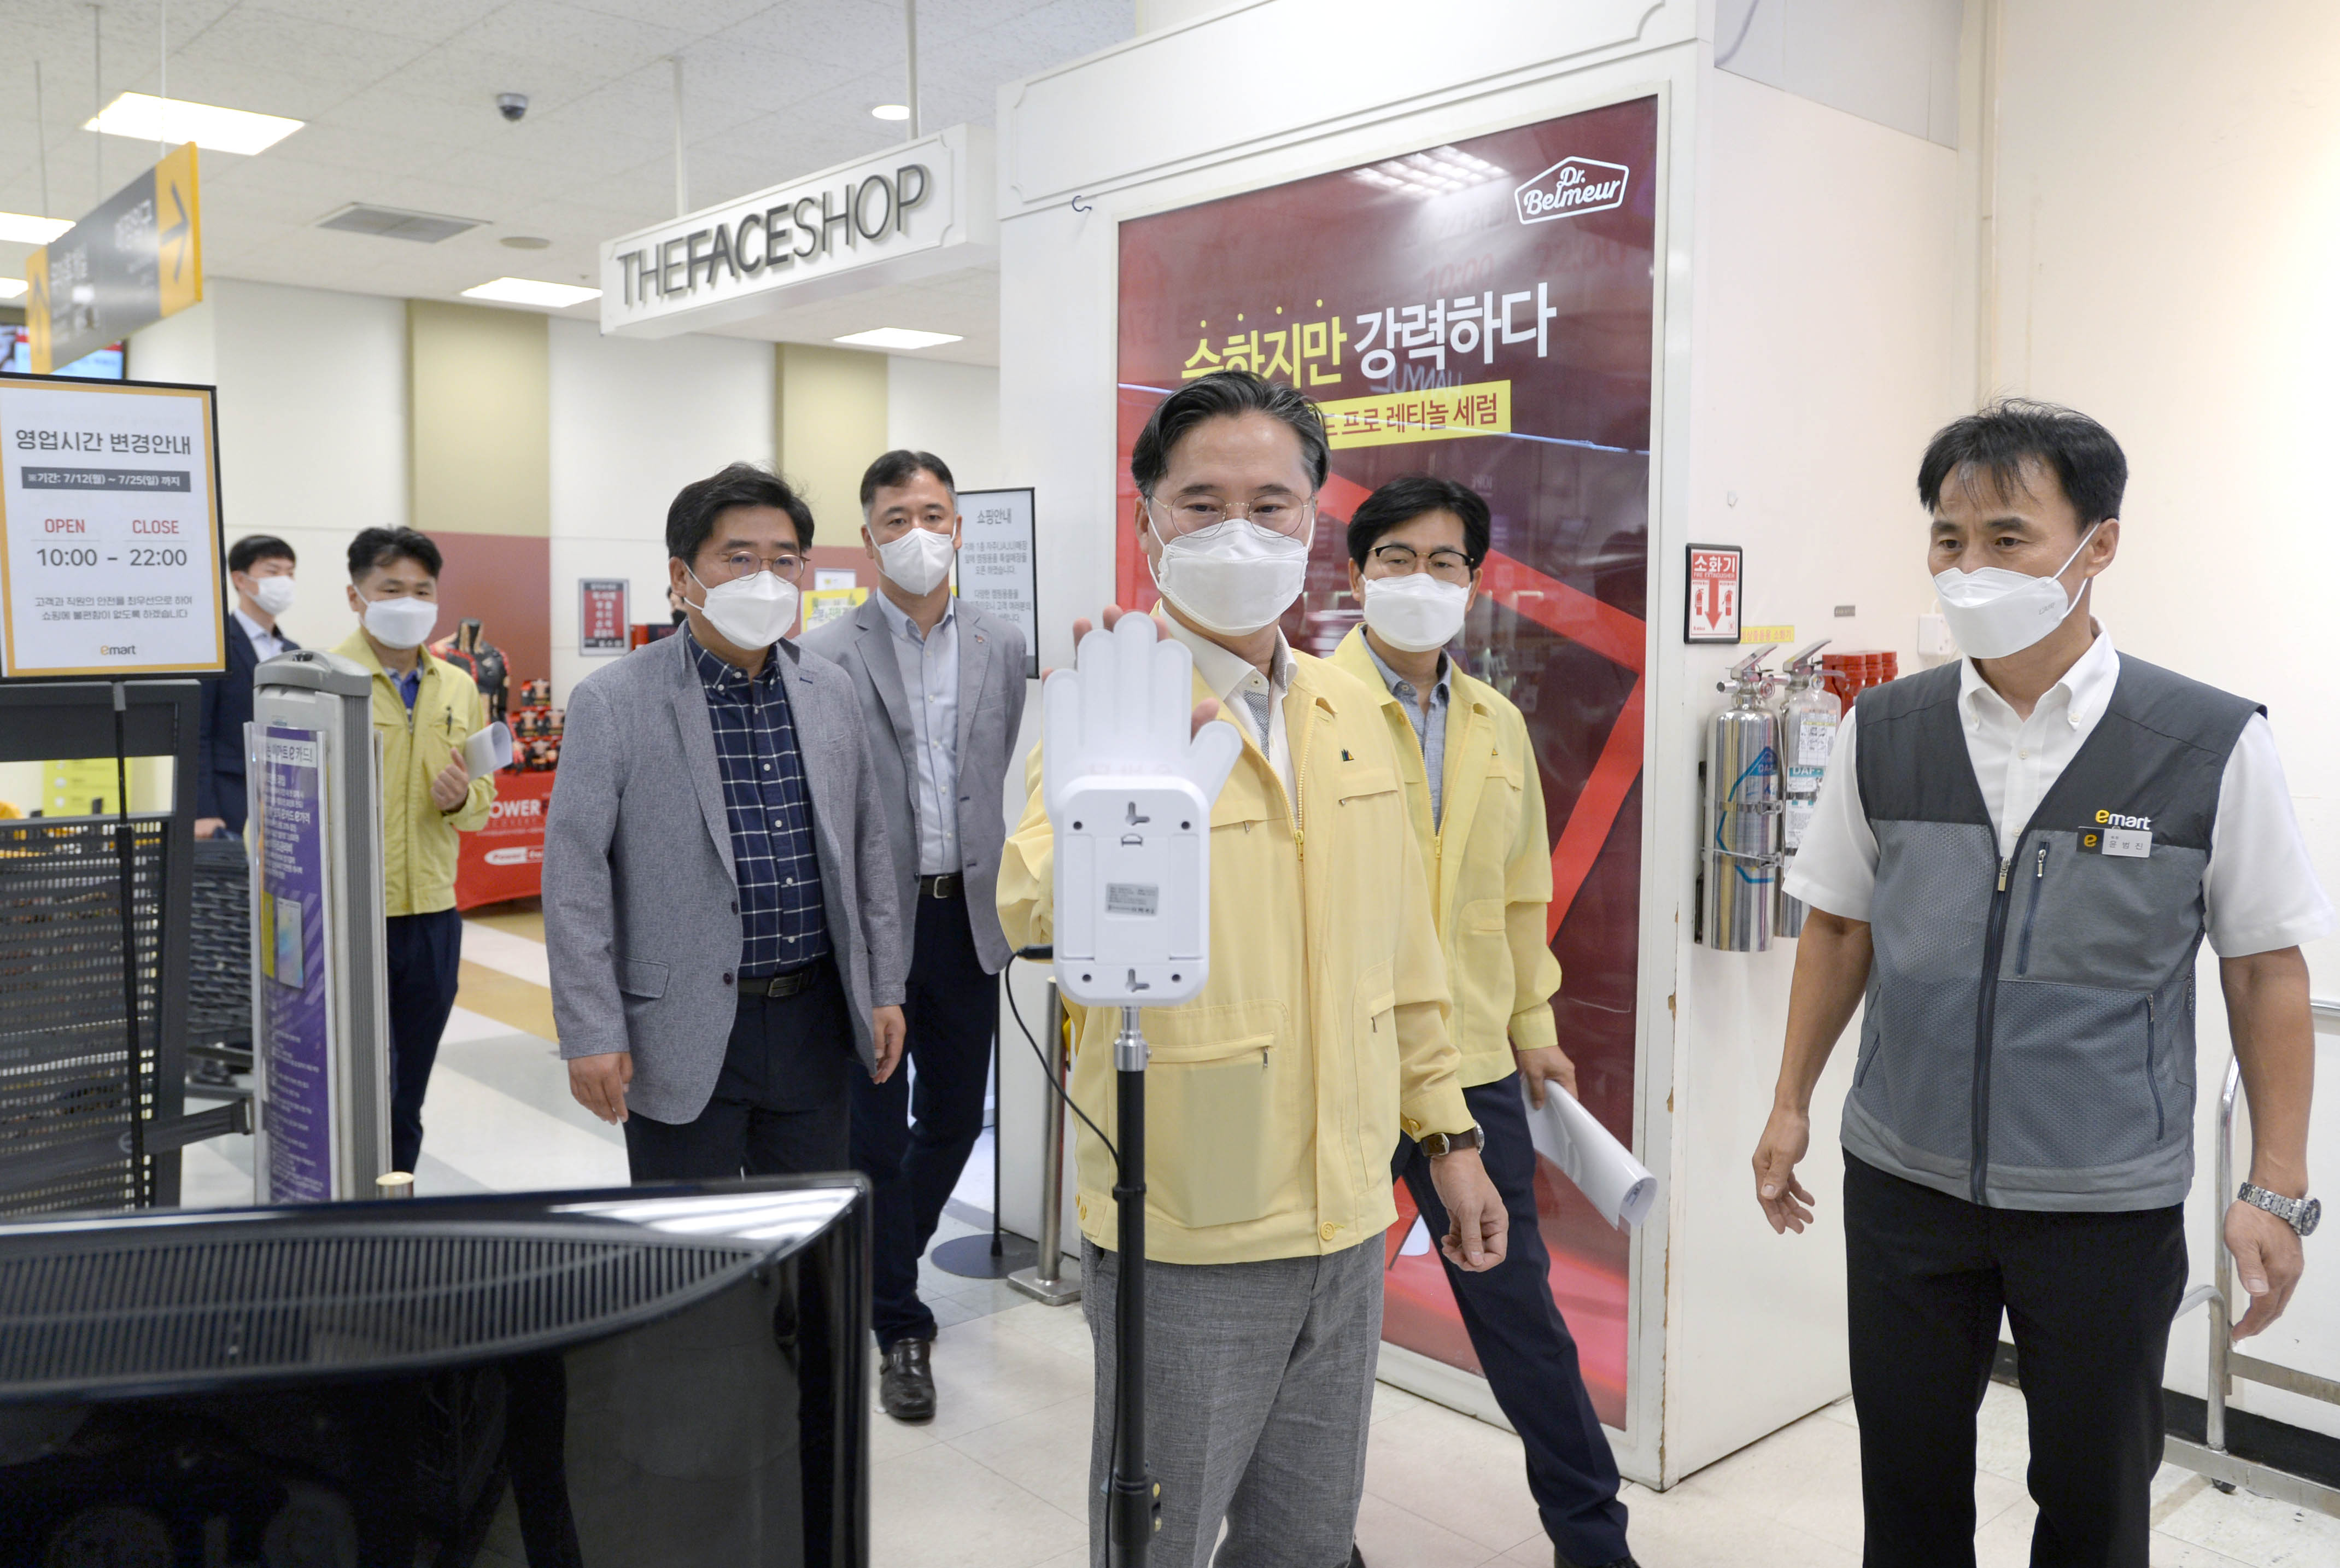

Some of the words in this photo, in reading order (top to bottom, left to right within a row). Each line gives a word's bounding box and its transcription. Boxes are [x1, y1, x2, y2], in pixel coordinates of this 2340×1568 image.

[1558, 166, 1586, 186] Dr.
[1523, 181, 1621, 215] Belmeur
[1354, 282, 1557, 379] 강력하다
[1341, 408, 1382, 435] 프로
[1387, 400, 1449, 433] 레티놀
[1453, 393, 1497, 426] 세럼
[16, 429, 104, 452] 영업시간
[110, 433, 191, 455] 변경안내
[63, 473, 106, 485] 7/12(월)
[118, 475, 159, 486] 7/25(일)
[161, 476, 180, 486] 까지
[976, 507, 1012, 525] 쇼핑안내
[44, 518, 85, 534] OPEN
[132, 520, 180, 535] CLOSE
[36, 548, 98, 566] 10:00
[130, 548, 188, 566] 22:00
[1694, 555, 1736, 573] 소화기
[35, 596, 64, 607] 고객과
[67, 596, 95, 606] 직원의
[127, 595, 172, 606] 최우선으로
[175, 595, 192, 605] 하여
[42, 610, 71, 621] 쇼핑에
[113, 609, 141, 619] 없도록
[143, 609, 188, 618] 하겠습니다
[100, 645, 136, 656] emart
[2095, 809, 2152, 830] emart
